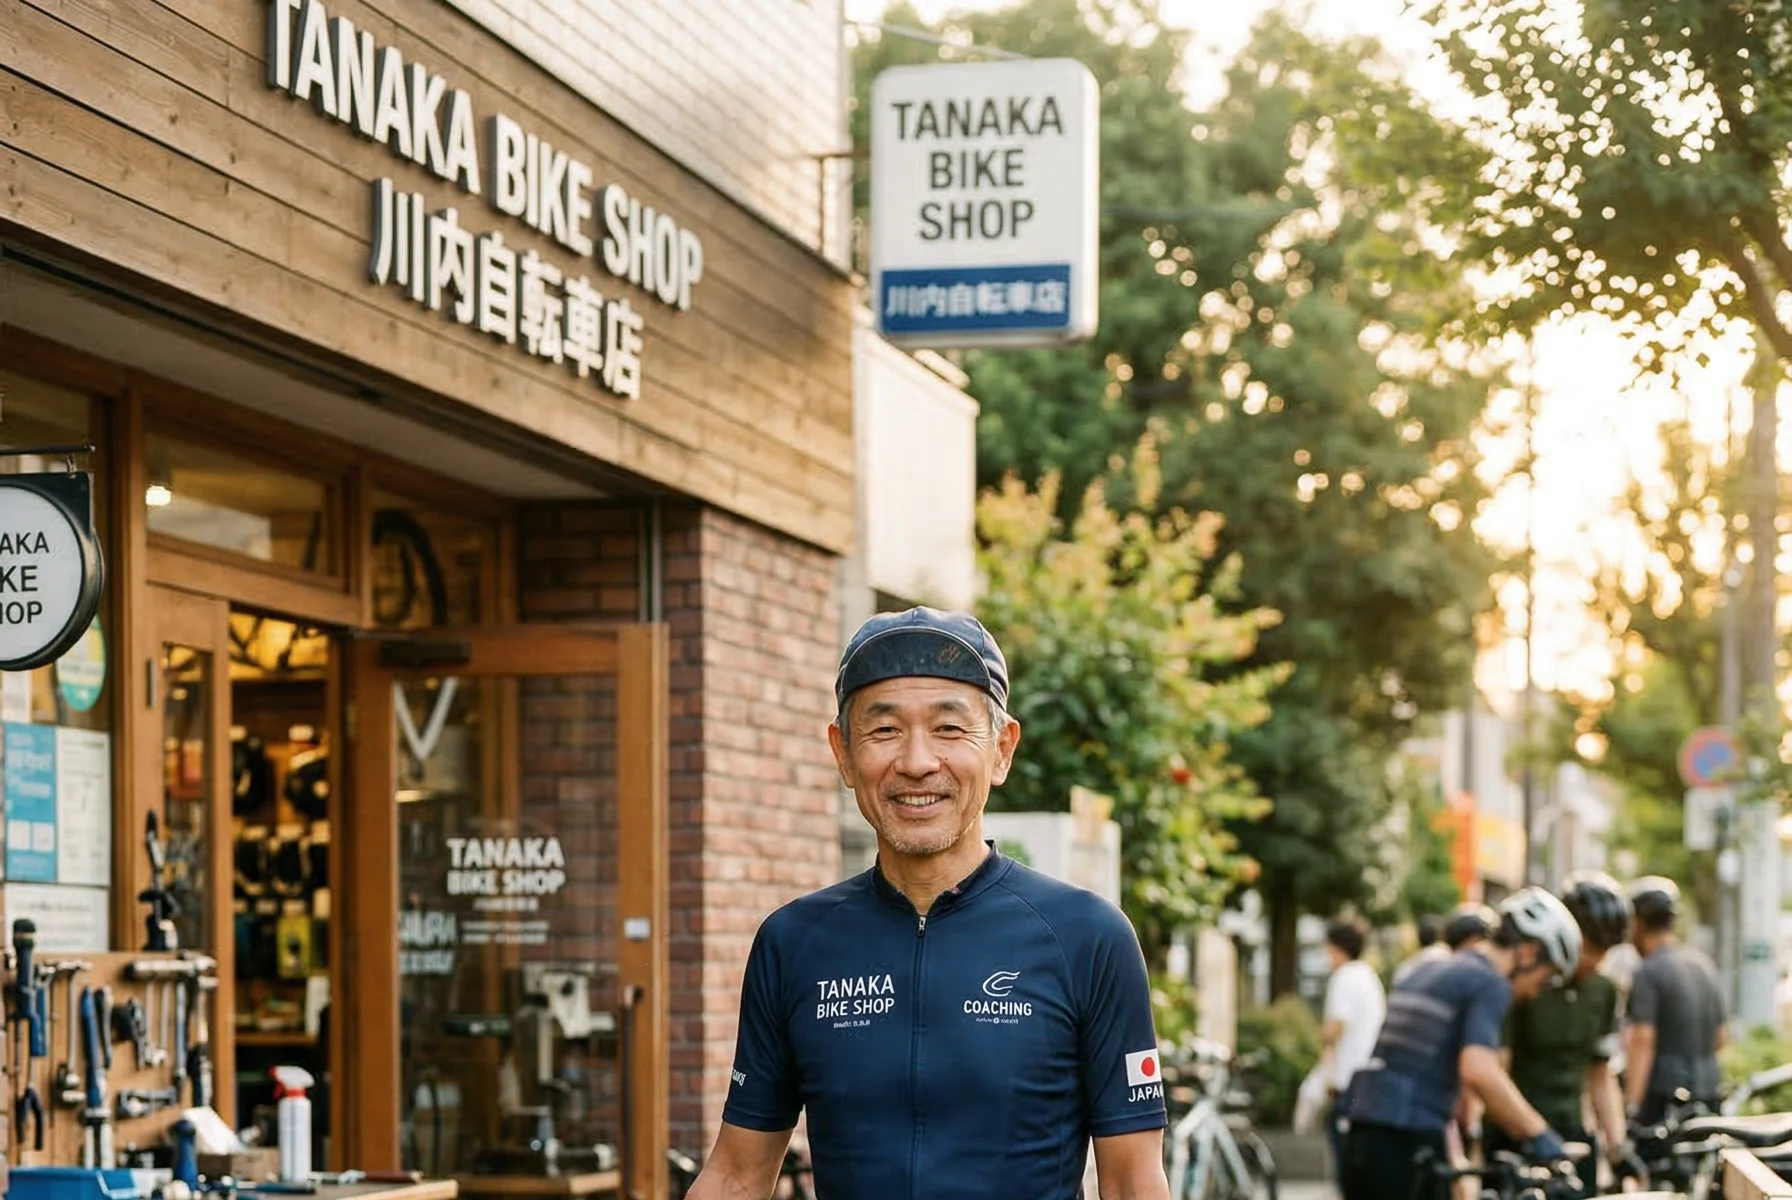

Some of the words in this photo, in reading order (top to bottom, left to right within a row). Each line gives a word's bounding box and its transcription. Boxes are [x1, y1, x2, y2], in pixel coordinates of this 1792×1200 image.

[891, 96, 1064, 140] TANAKA
[274, 0, 481, 195] TANAKA
[495, 113, 594, 257] BIKE
[603, 184, 702, 311] SHOP
[929, 148, 1025, 190] BIKE
[920, 200, 1034, 240] SHOP
[373, 177, 644, 401] 川内自転車店
[0, 600, 43, 625] OP
[446, 837, 565, 868] TANAKA
[447, 869, 497, 895] BIKE
[503, 869, 566, 895] SHOP
[817, 974, 895, 1001] TANAKA
[816, 1001, 849, 1020] BIKE
[853, 998, 895, 1015] SHOP
[963, 999, 1033, 1017] COACHING
